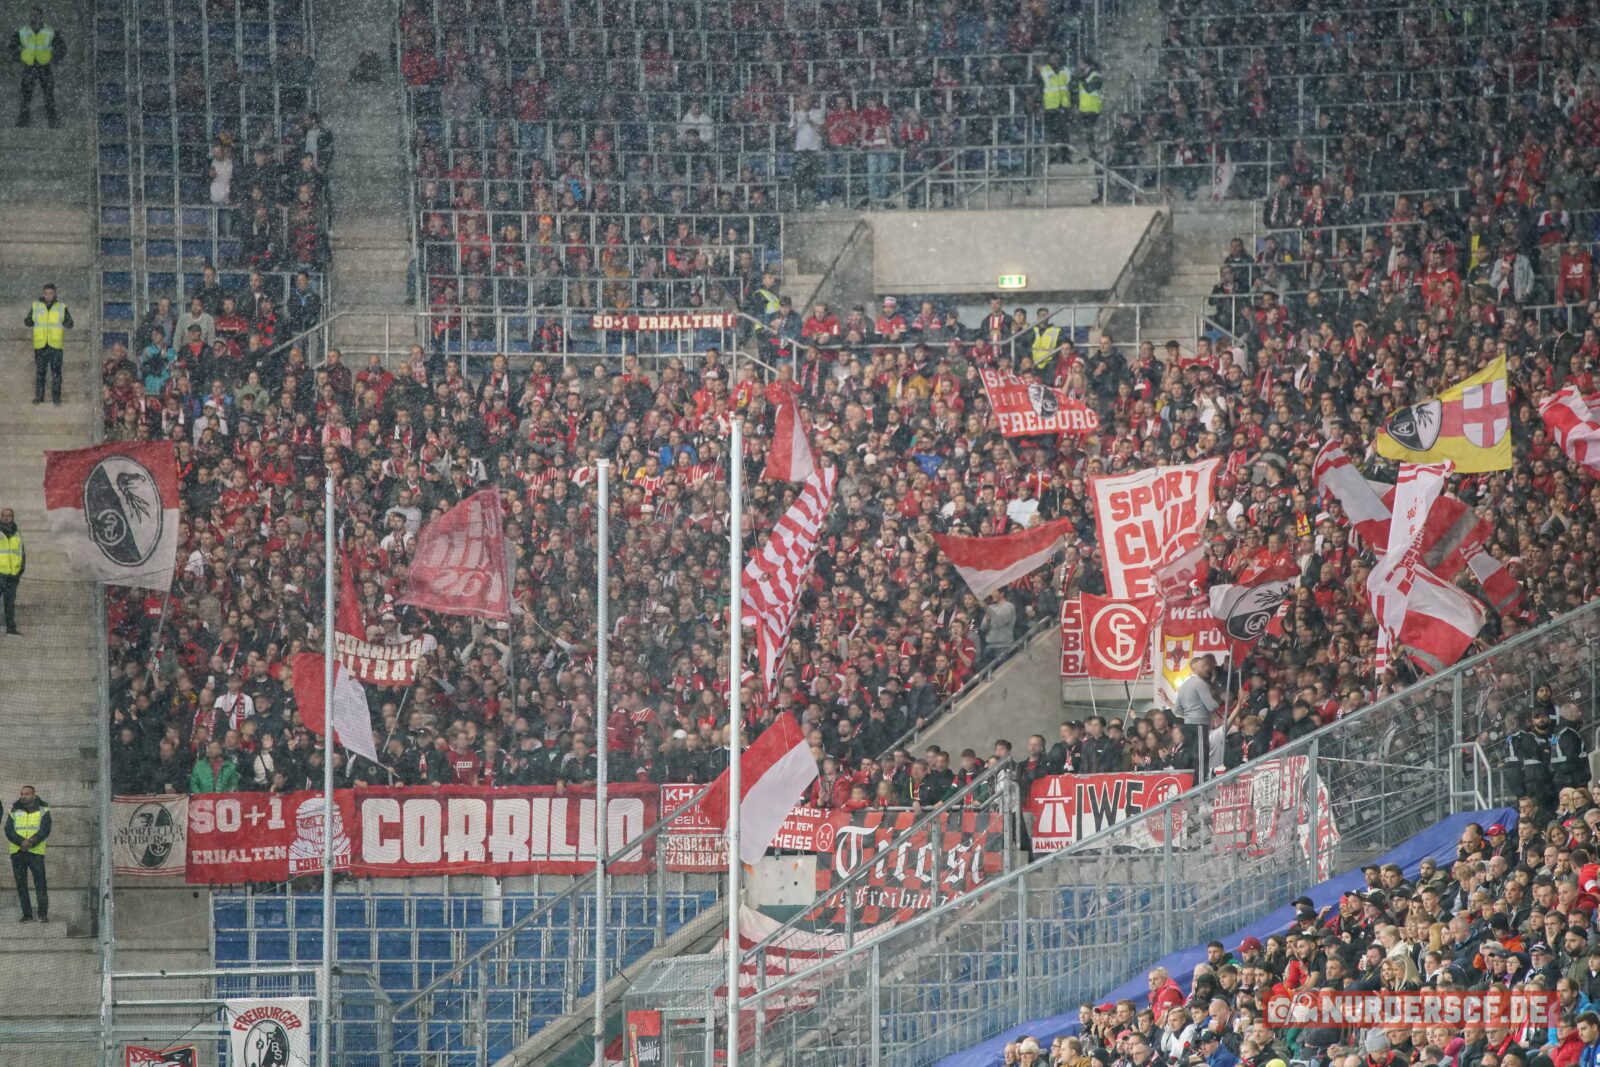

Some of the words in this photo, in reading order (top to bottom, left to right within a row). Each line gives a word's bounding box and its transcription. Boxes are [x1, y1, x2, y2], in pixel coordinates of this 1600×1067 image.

[592, 315, 629, 329] 50+1
[999, 409, 1098, 434] FREIBURG
[1108, 470, 1199, 522] SPORT
[361, 797, 645, 864] CORRILLO
[191, 845, 287, 865] ERHALTEN
[232, 1006, 302, 1032] FREIBURGER
